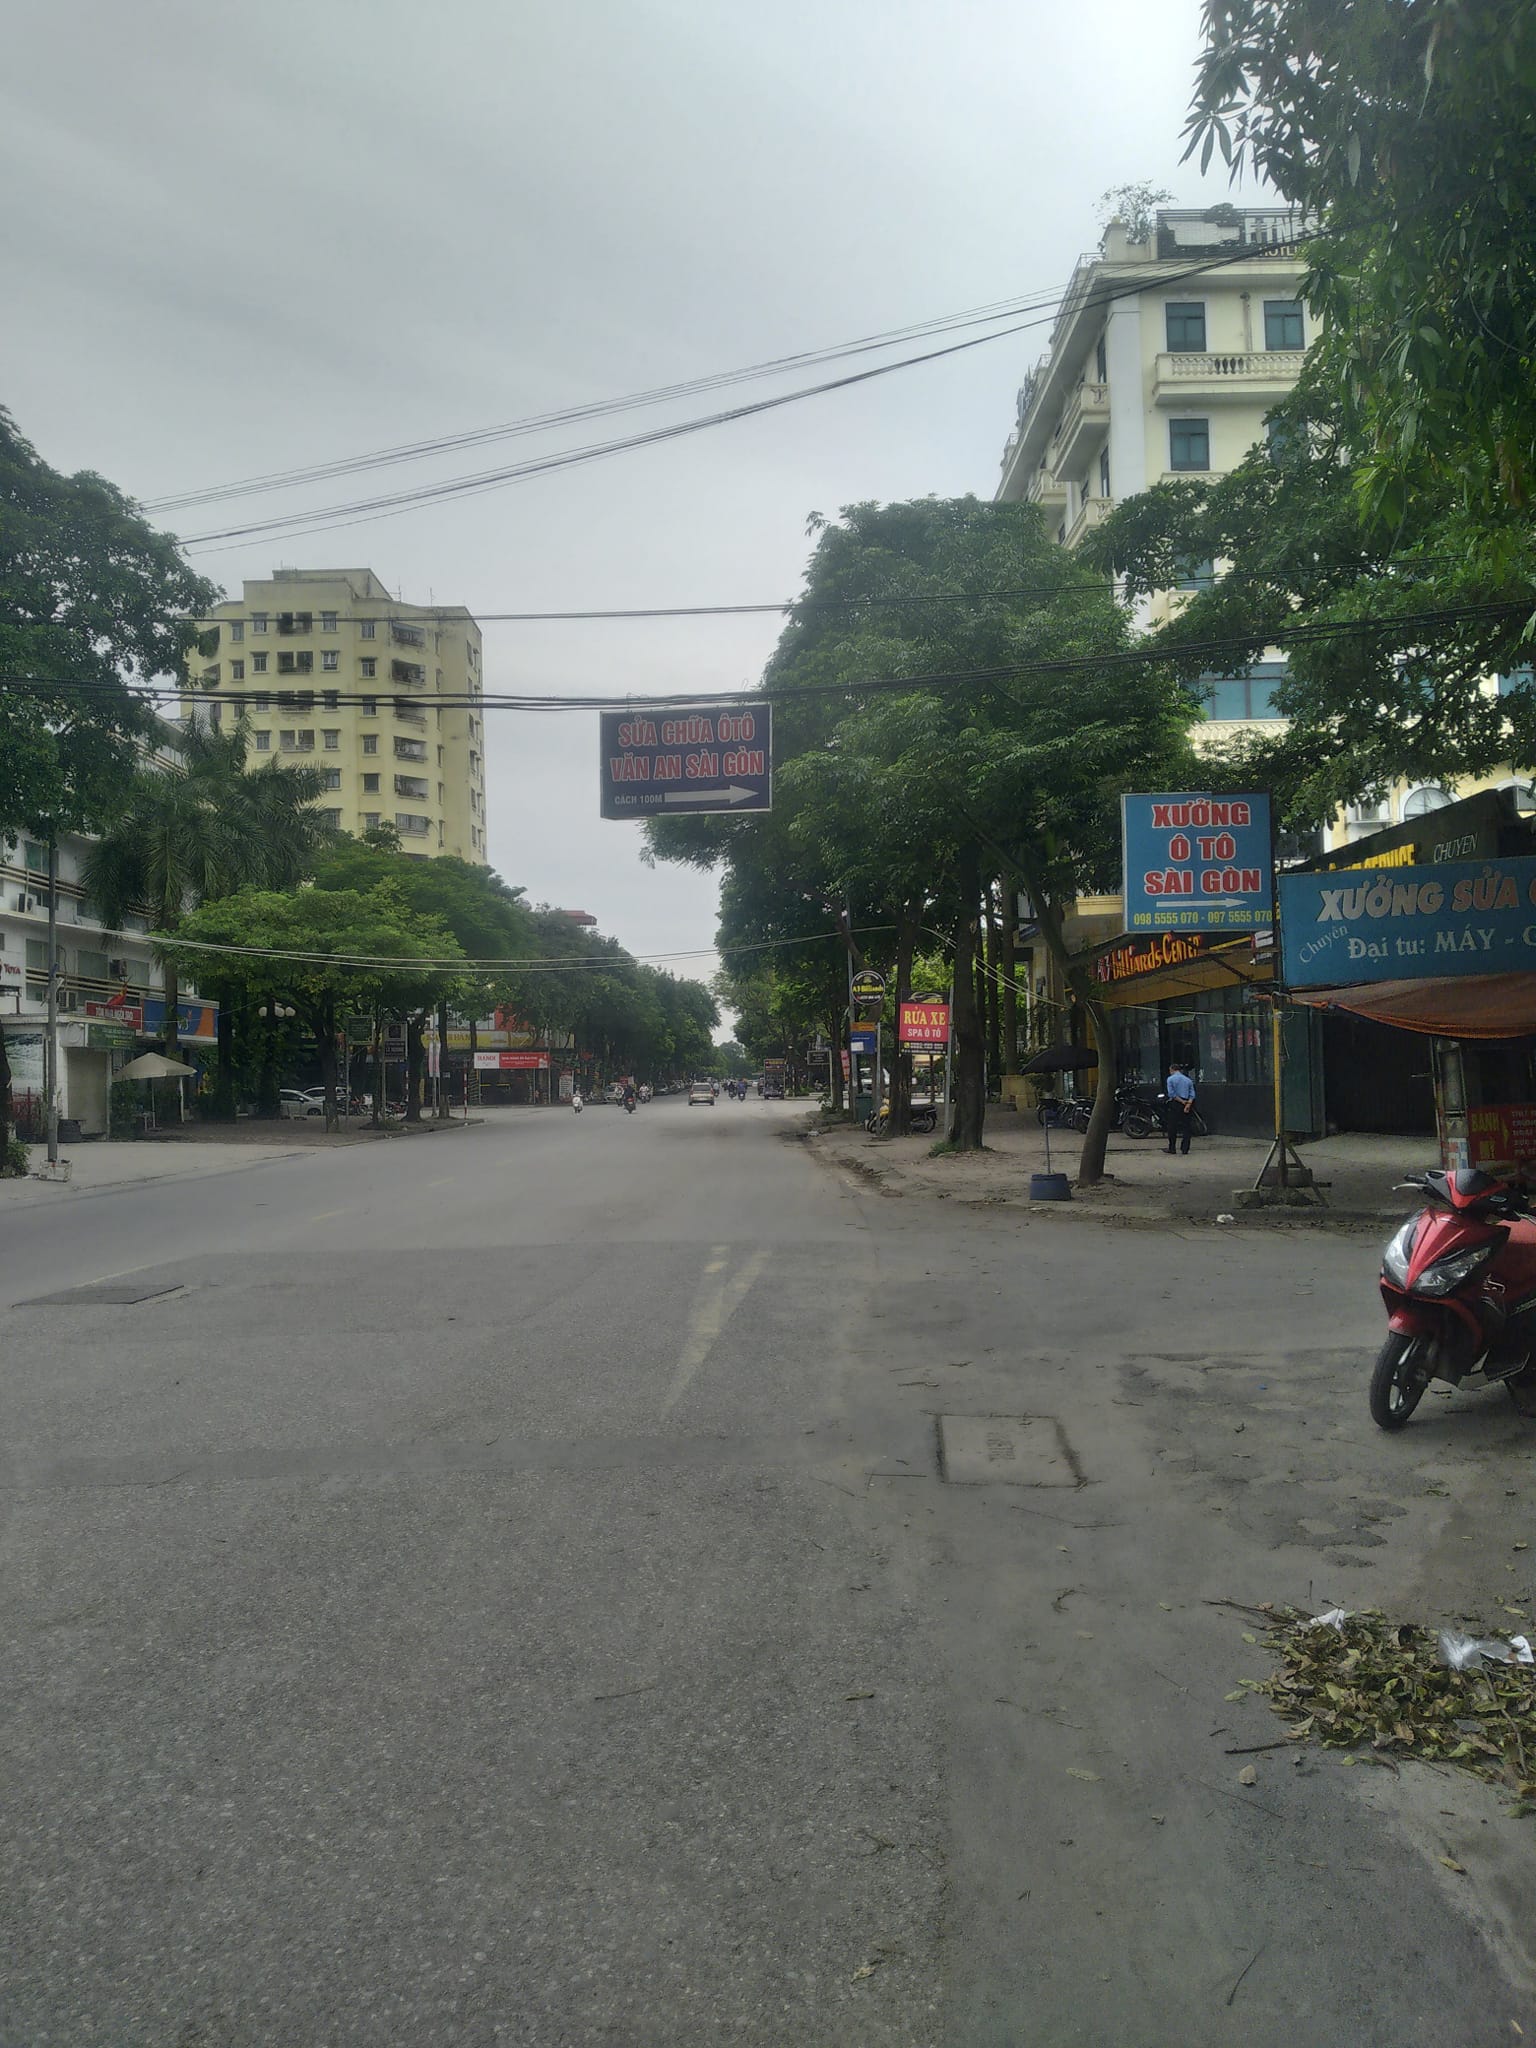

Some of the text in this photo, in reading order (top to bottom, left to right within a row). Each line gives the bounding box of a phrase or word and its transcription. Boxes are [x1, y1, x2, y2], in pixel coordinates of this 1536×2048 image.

[618, 712, 755, 747] SỬA CHỮA ÔTÔ
[610, 746, 764, 782] VĂN AN SÀI GÒN
[1152, 798, 1250, 829] XƯỞNG
[1169, 832, 1236, 862] Ô TÔ
[1144, 865, 1262, 895] SÀI GÒN
[1316, 875, 1445, 922] XƯỞNG
[1452, 866, 1520, 913] SỬA
[1133, 912, 1152, 925] 098
[1154, 912, 1178, 924] 5555
[1180, 911, 1199, 924] 070
[1207, 911, 1225, 923] 097
[1228, 911, 1251, 922] 5555
[1348, 936, 1389, 963] Đại
[1434, 923, 1496, 953] MÁY
[903, 1006, 946, 1026] RỬA XE
[907, 1027, 942, 1038] SPA Ô TÔ
